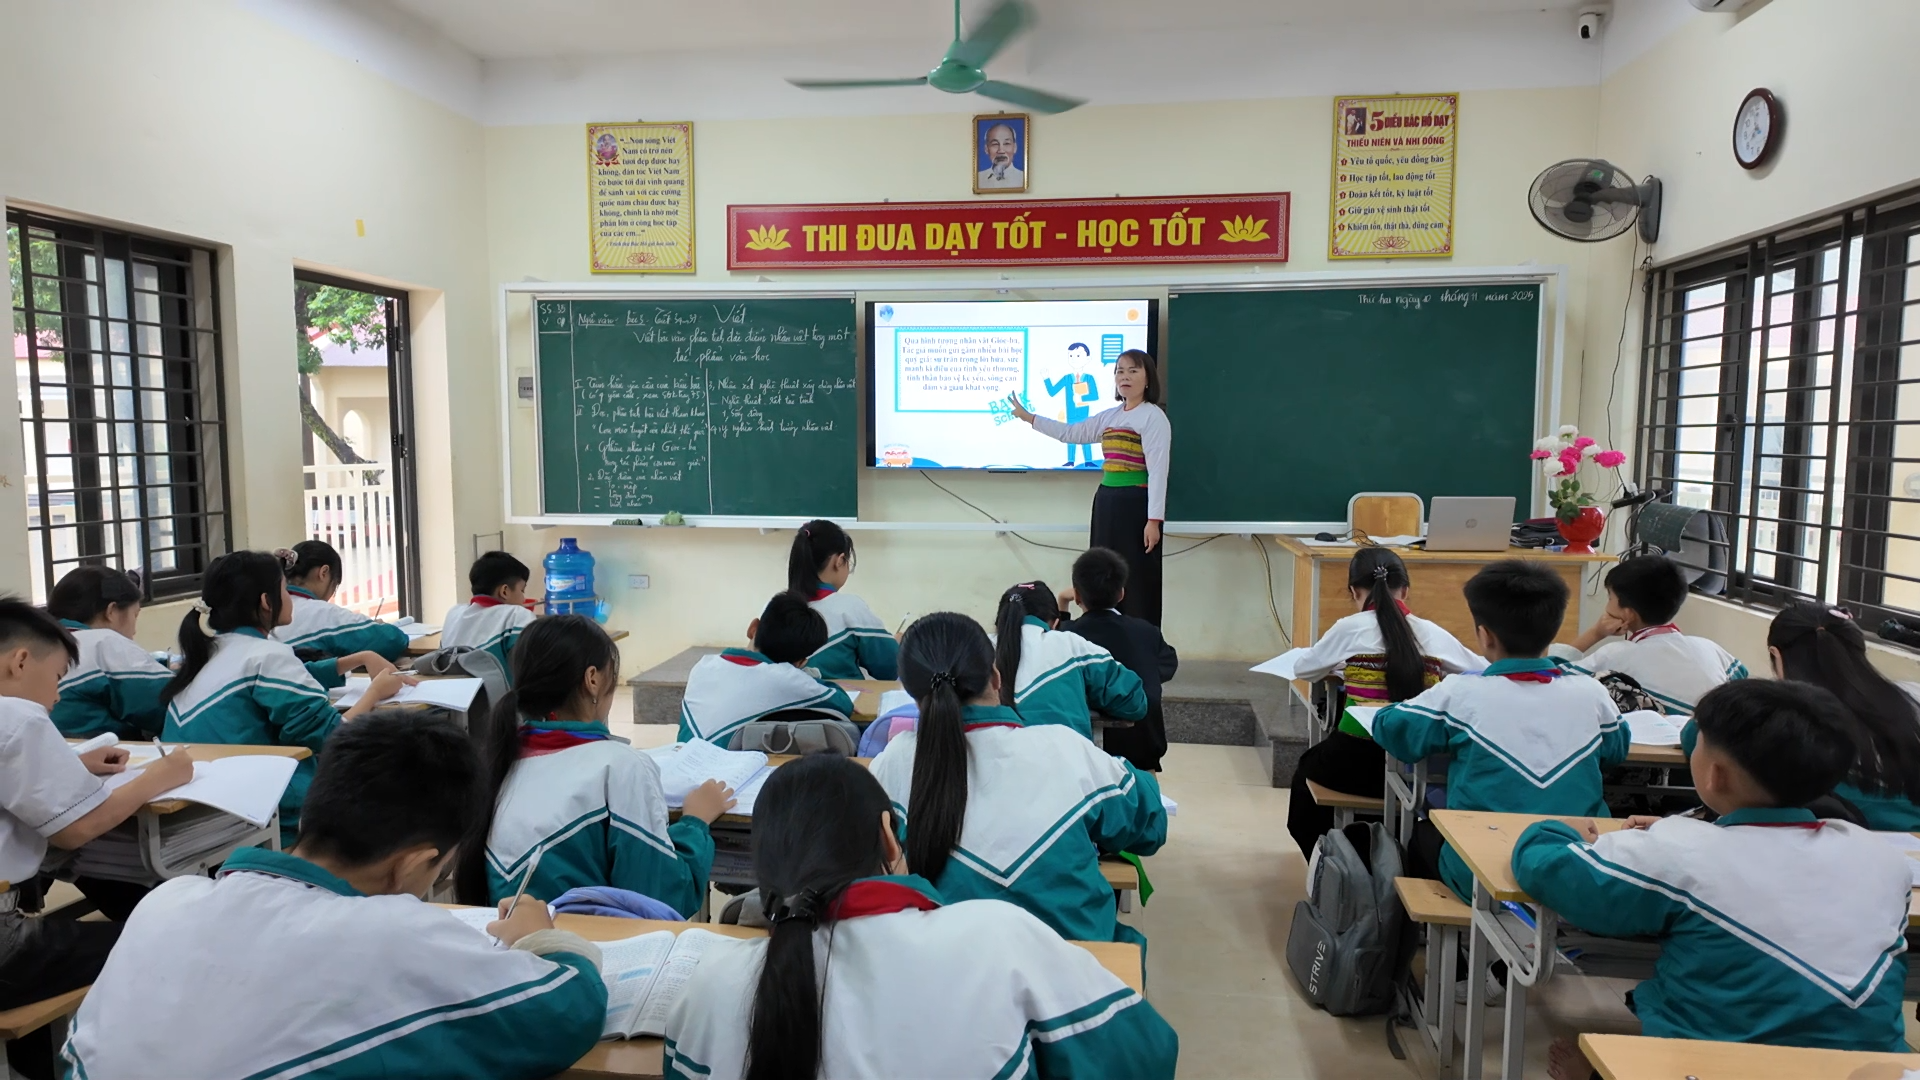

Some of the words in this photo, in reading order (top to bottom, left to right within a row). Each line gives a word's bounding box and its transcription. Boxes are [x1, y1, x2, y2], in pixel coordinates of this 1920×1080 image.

[1370, 111, 1384, 131] 5
[1434, 115, 1449, 129] DẠY
[1346, 136, 1369, 147] THIẾU
[1371, 137, 1391, 146] NIÊN
[1393, 136, 1403, 146] VÀ
[1406, 137, 1420, 145] NHI
[1422, 134, 1444, 144] ĐỒNG
[1350, 157, 1364, 165] Yêu
[1397, 157, 1408, 165] yêu
[1411, 154, 1429, 164] đồng
[1349, 174, 1363, 183] Học
[1366, 174, 1377, 183] tập
[1405, 172, 1423, 182] động
[1426, 170, 1435, 180] tốt
[1370, 188, 1381, 197] kết
[1407, 189, 1421, 198] luật
[1424, 187, 1433, 196] tốt
[1348, 206, 1362, 214] Giữ
[1363, 206, 1375, 215] gìn
[1377, 206, 1385, 215] vệ
[1404, 205, 1418, 213] thật
[1420, 203, 1430, 212] tốt
[802, 224, 848, 252] THI
[856, 223, 916, 251] ĐUA
[925, 222, 984, 256] DẠY
[992, 212, 1047, 250] TỐT
[1077, 219, 1139, 252] HỌC
[1150, 207, 1206, 246] TỐT
[1395, 294, 1421, 309] ngày
[1440, 289, 1469, 307] tháng
[1472, 293, 1478, 301] 11
[1485, 293, 1507, 301] năm
[1511, 290, 1534, 301] 2025
[713, 303, 746, 324] Viết
[828, 327, 850, 340] một
[1309, 940, 1326, 996] STRIVE
